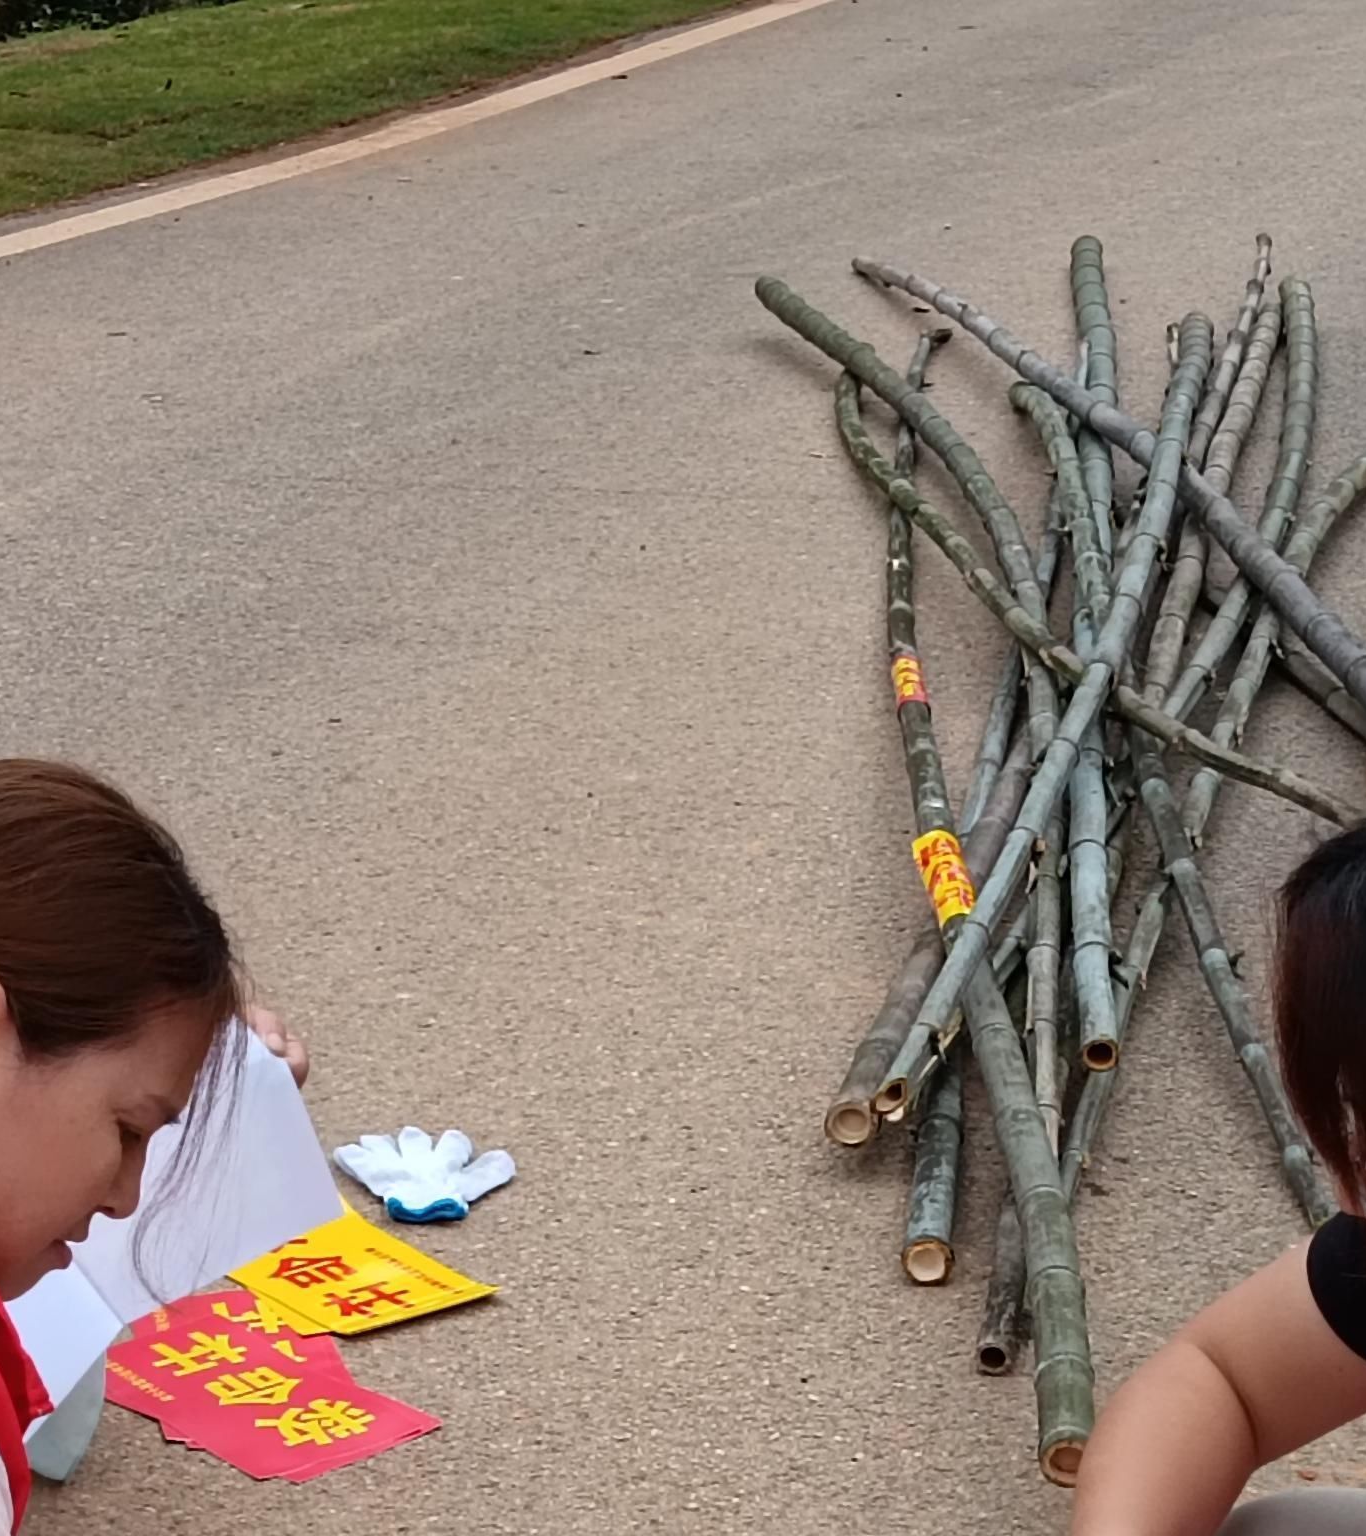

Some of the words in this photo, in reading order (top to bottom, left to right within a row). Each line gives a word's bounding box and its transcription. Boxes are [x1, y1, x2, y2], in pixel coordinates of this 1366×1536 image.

[269, 1238, 416, 1318] 命杆
[148, 1330, 376, 1447] 救命杆
